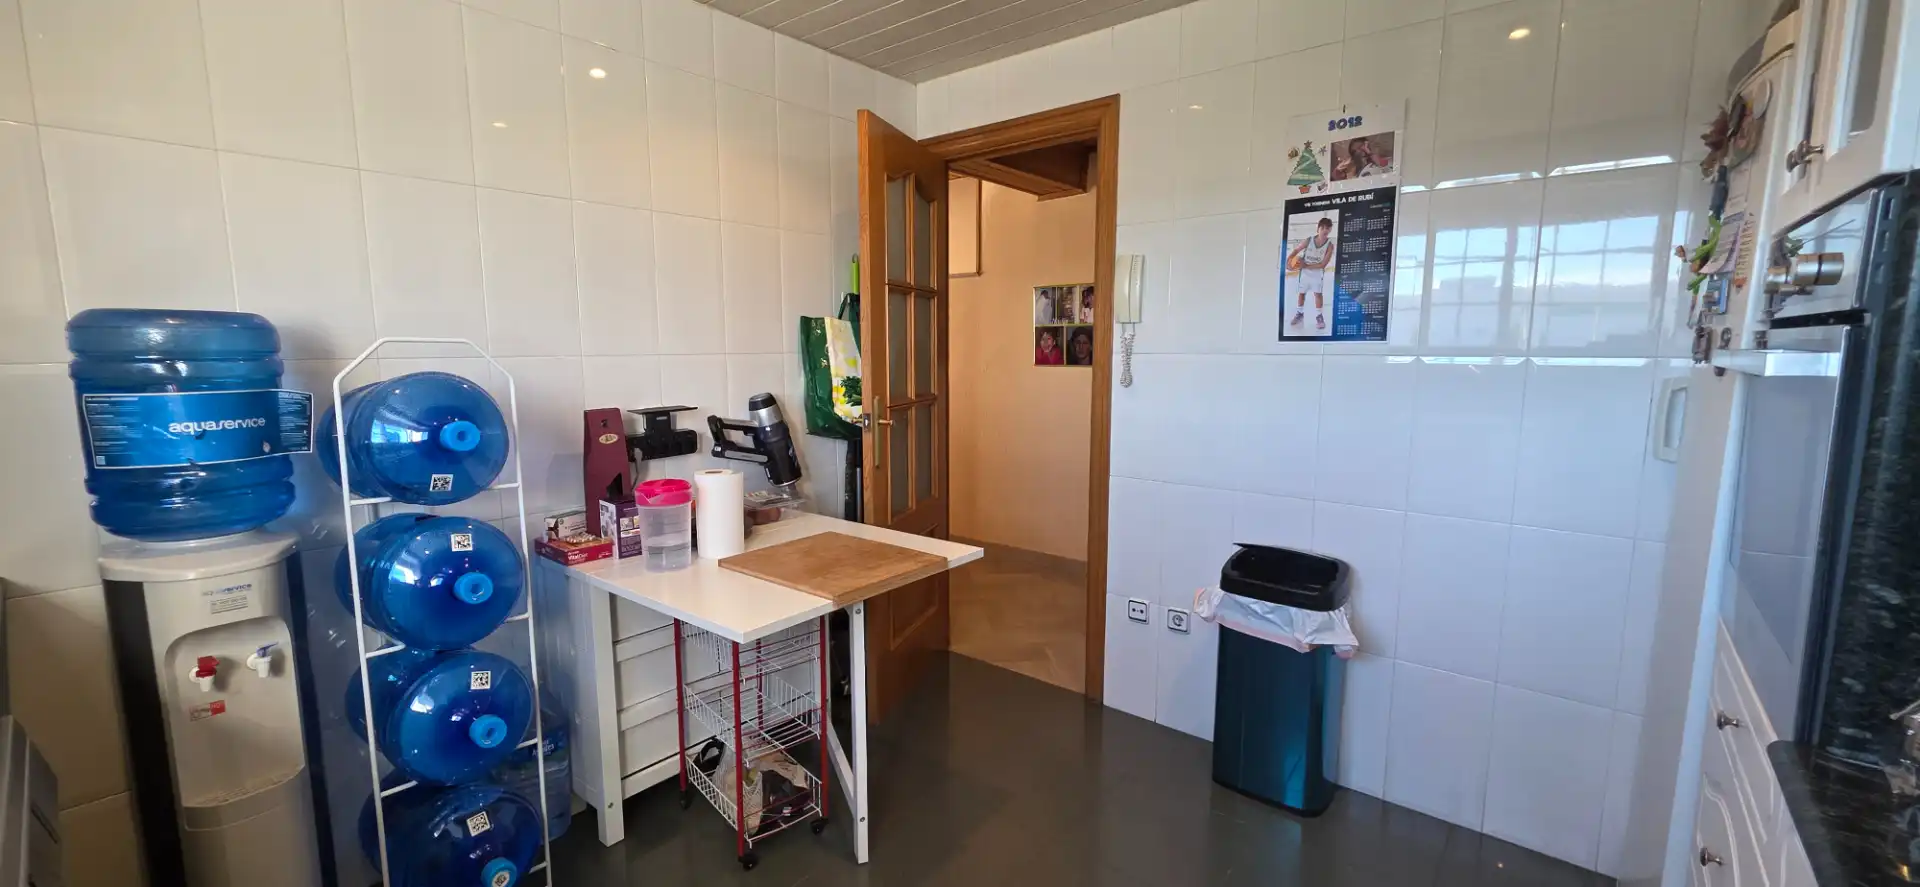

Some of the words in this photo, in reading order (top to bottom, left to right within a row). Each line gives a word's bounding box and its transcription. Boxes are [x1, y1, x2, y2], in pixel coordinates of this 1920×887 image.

[1328, 115, 1363, 131] 2012
[1331, 197, 1347, 205] VILA
[168, 417, 266, 435] aquaservice
